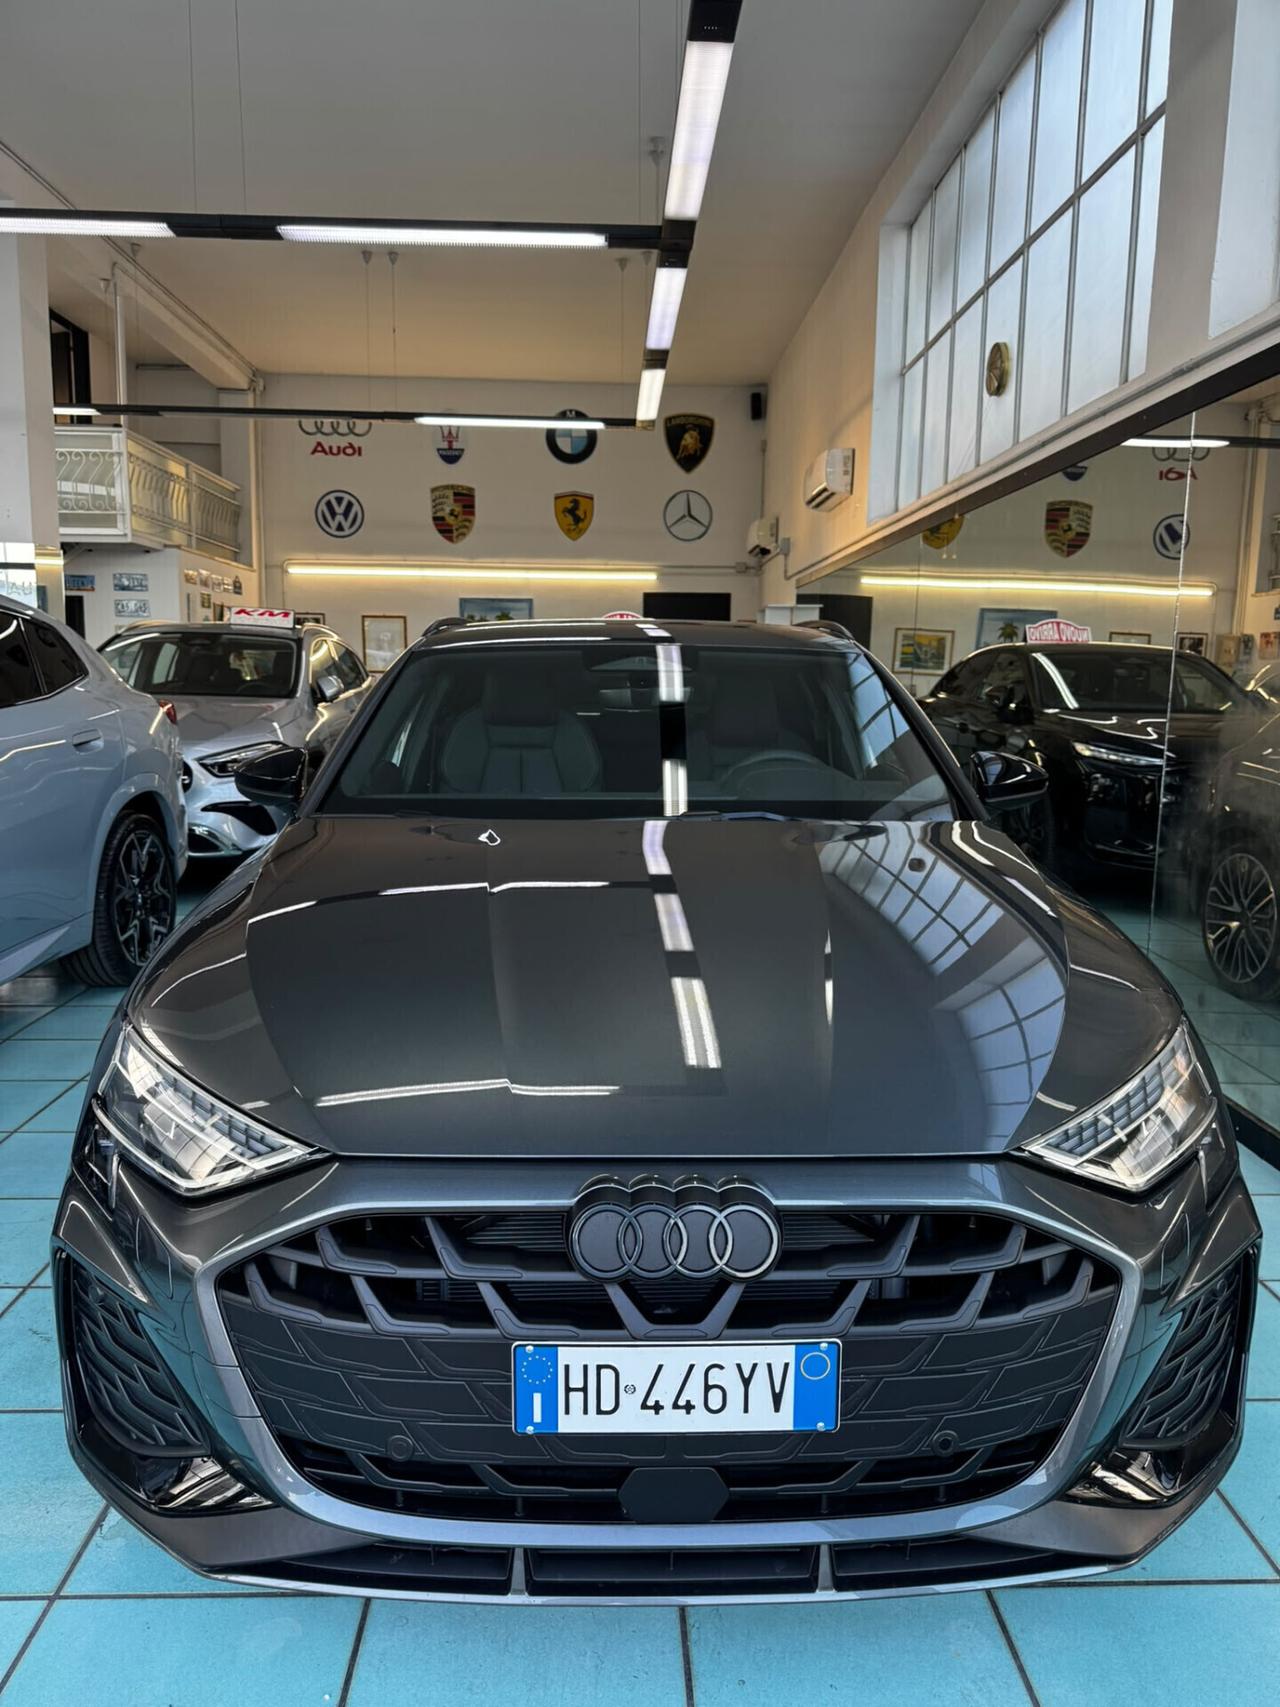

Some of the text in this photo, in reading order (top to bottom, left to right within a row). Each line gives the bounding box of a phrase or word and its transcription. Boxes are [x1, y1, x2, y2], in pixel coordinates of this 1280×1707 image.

[310, 441, 363, 457] Audi
[234, 608, 289, 618] KM
[563, 1361, 791, 1416] HD 446YV
